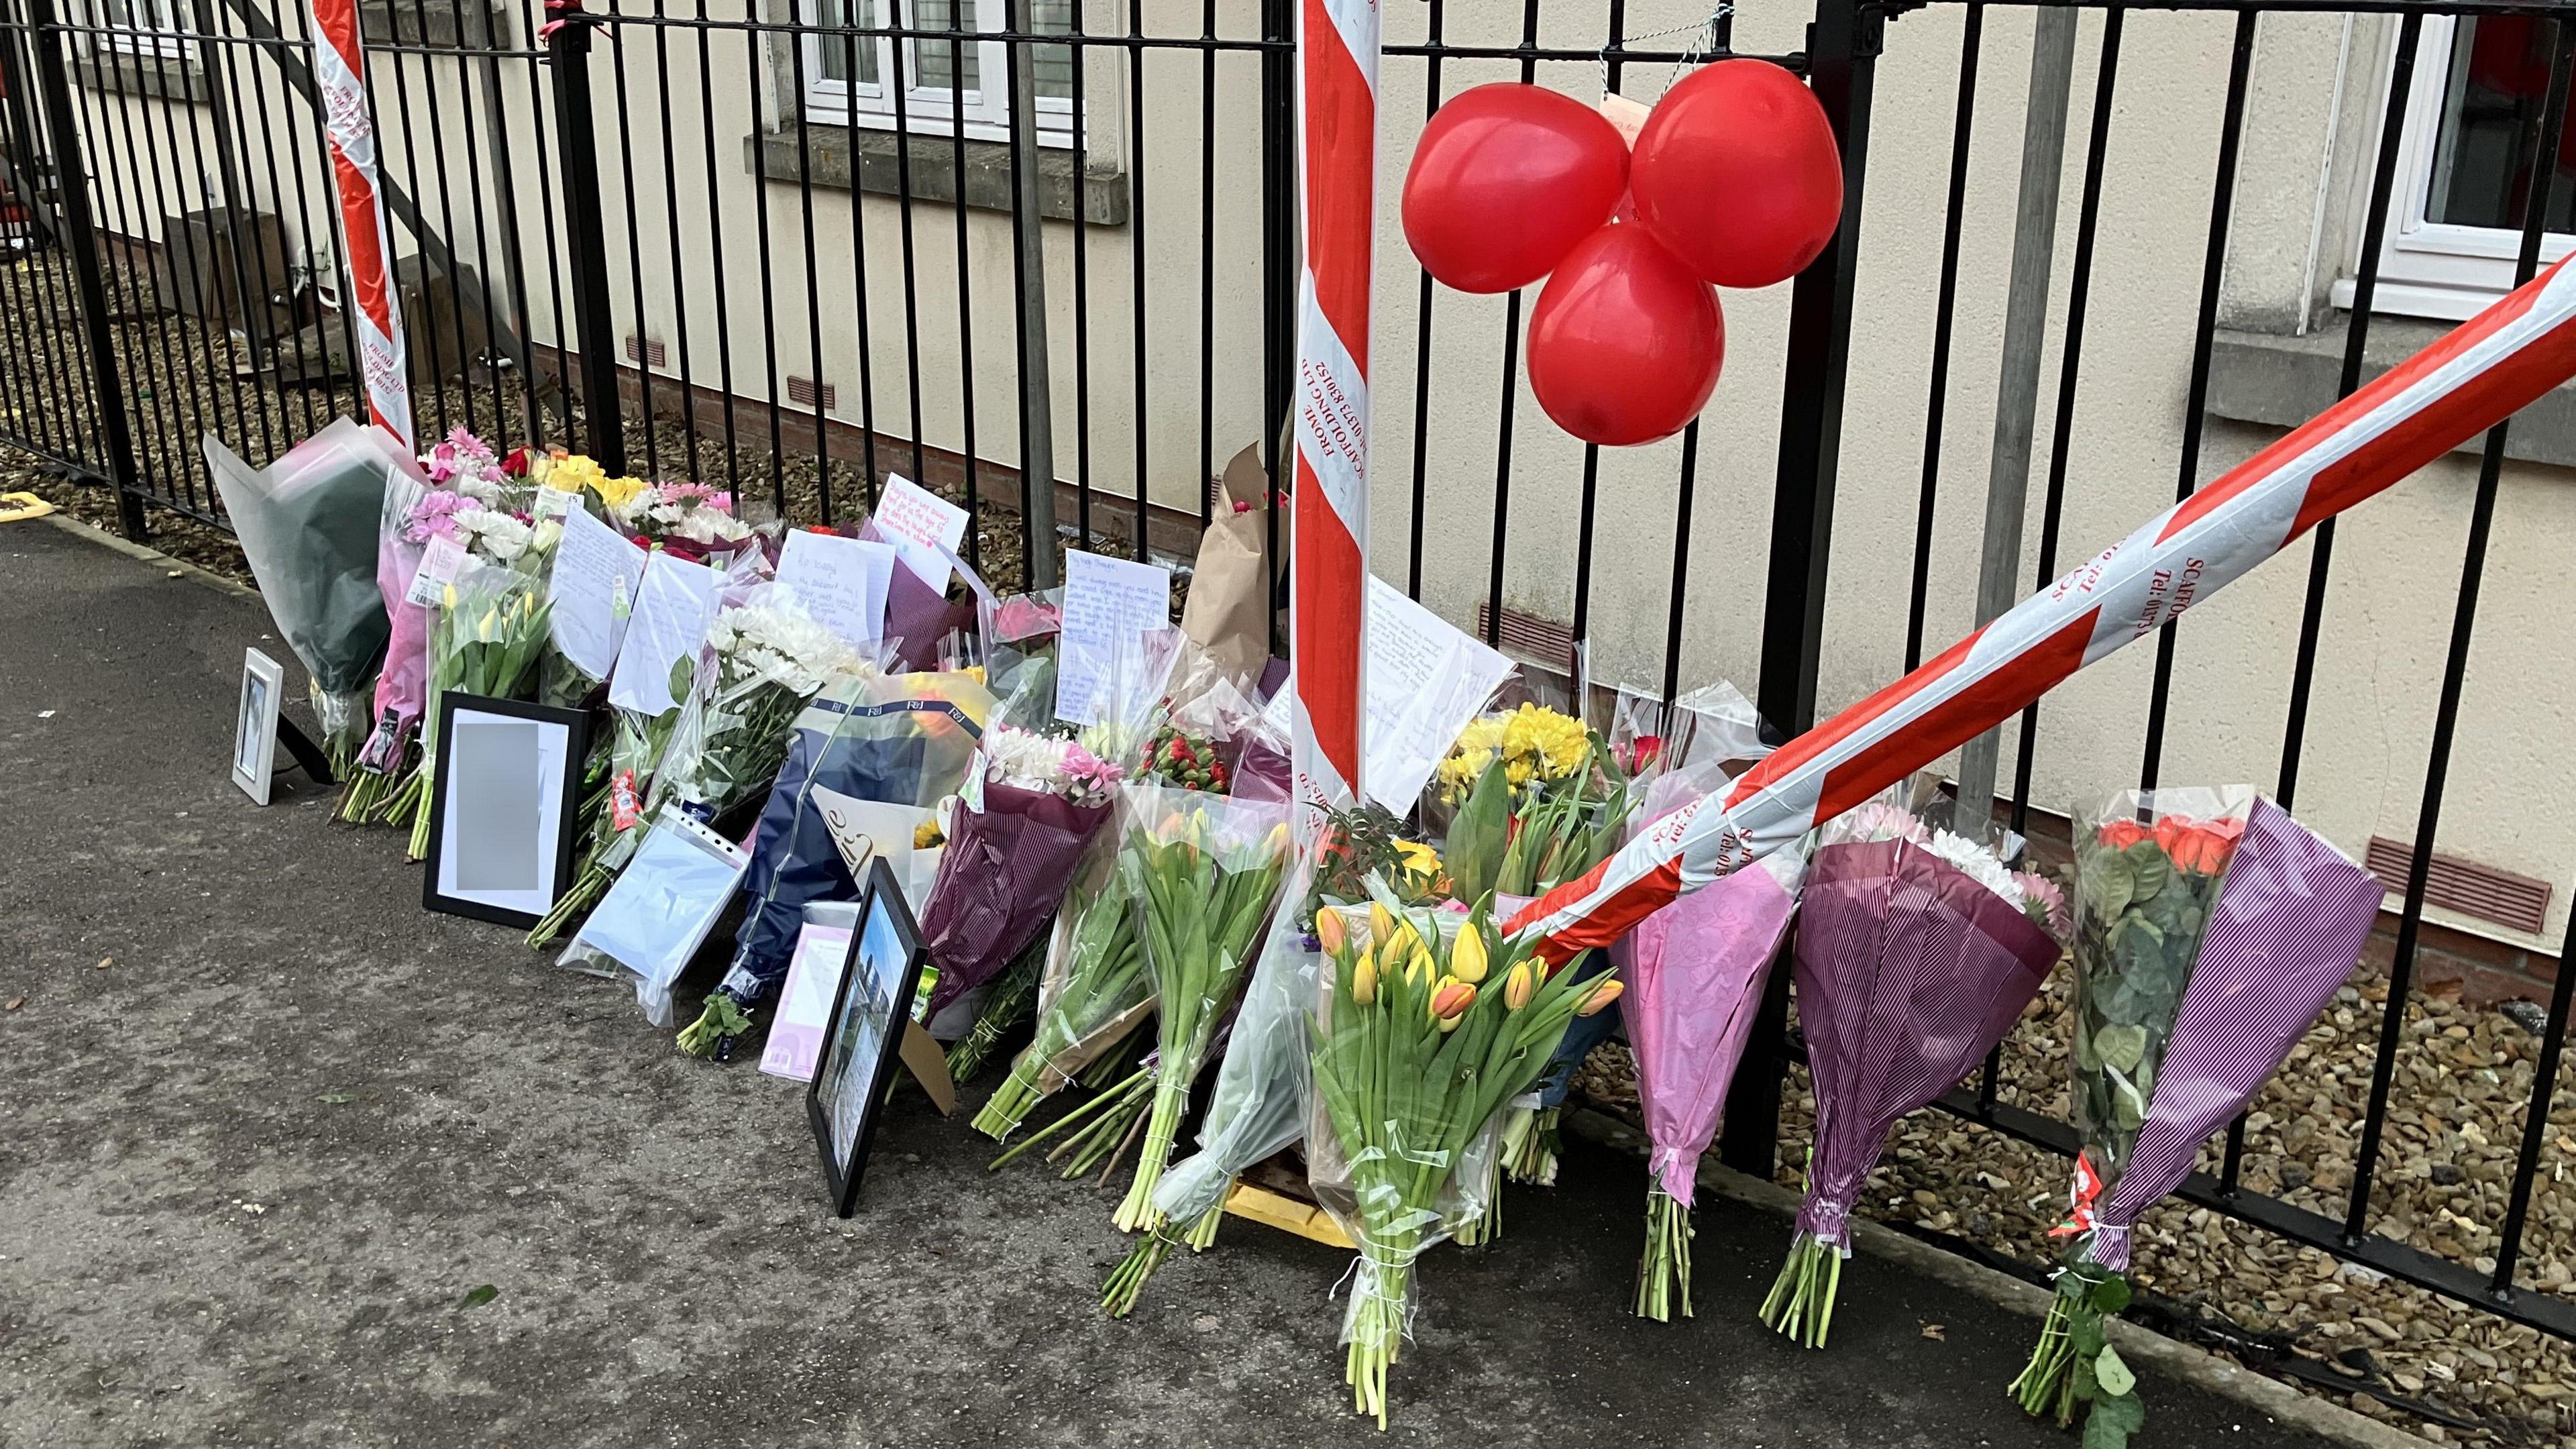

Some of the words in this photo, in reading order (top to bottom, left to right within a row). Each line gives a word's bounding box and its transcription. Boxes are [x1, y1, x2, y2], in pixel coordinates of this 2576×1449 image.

[1316, 362, 1344, 404] 830152
[1304, 405, 1335, 457] FROME
[1311, 388, 1364, 480] SCAFFOLDING
[1340, 404, 1362, 437] 01373
[2077, 565, 2102, 594] Tel:
[2149, 569, 2172, 596] Tel:
